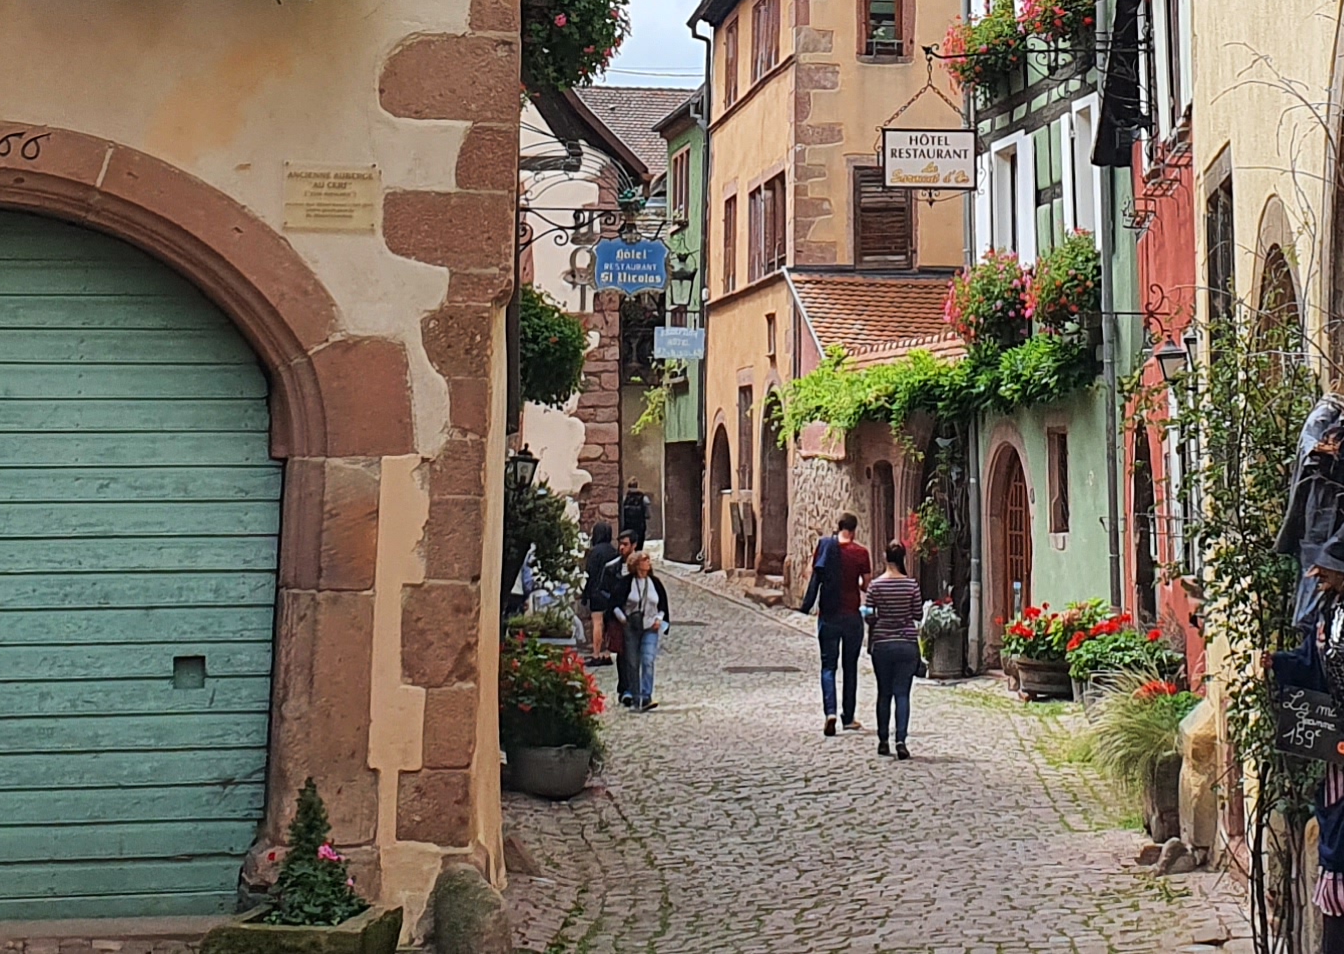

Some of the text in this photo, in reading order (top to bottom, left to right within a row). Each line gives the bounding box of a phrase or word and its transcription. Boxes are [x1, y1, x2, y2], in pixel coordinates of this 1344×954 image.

[909, 133, 951, 146] HÔTEL
[890, 148, 969, 160] RESTAURANT
[603, 263, 657, 271] RESTAURANT
[617, 272, 662, 285] Nicolas
